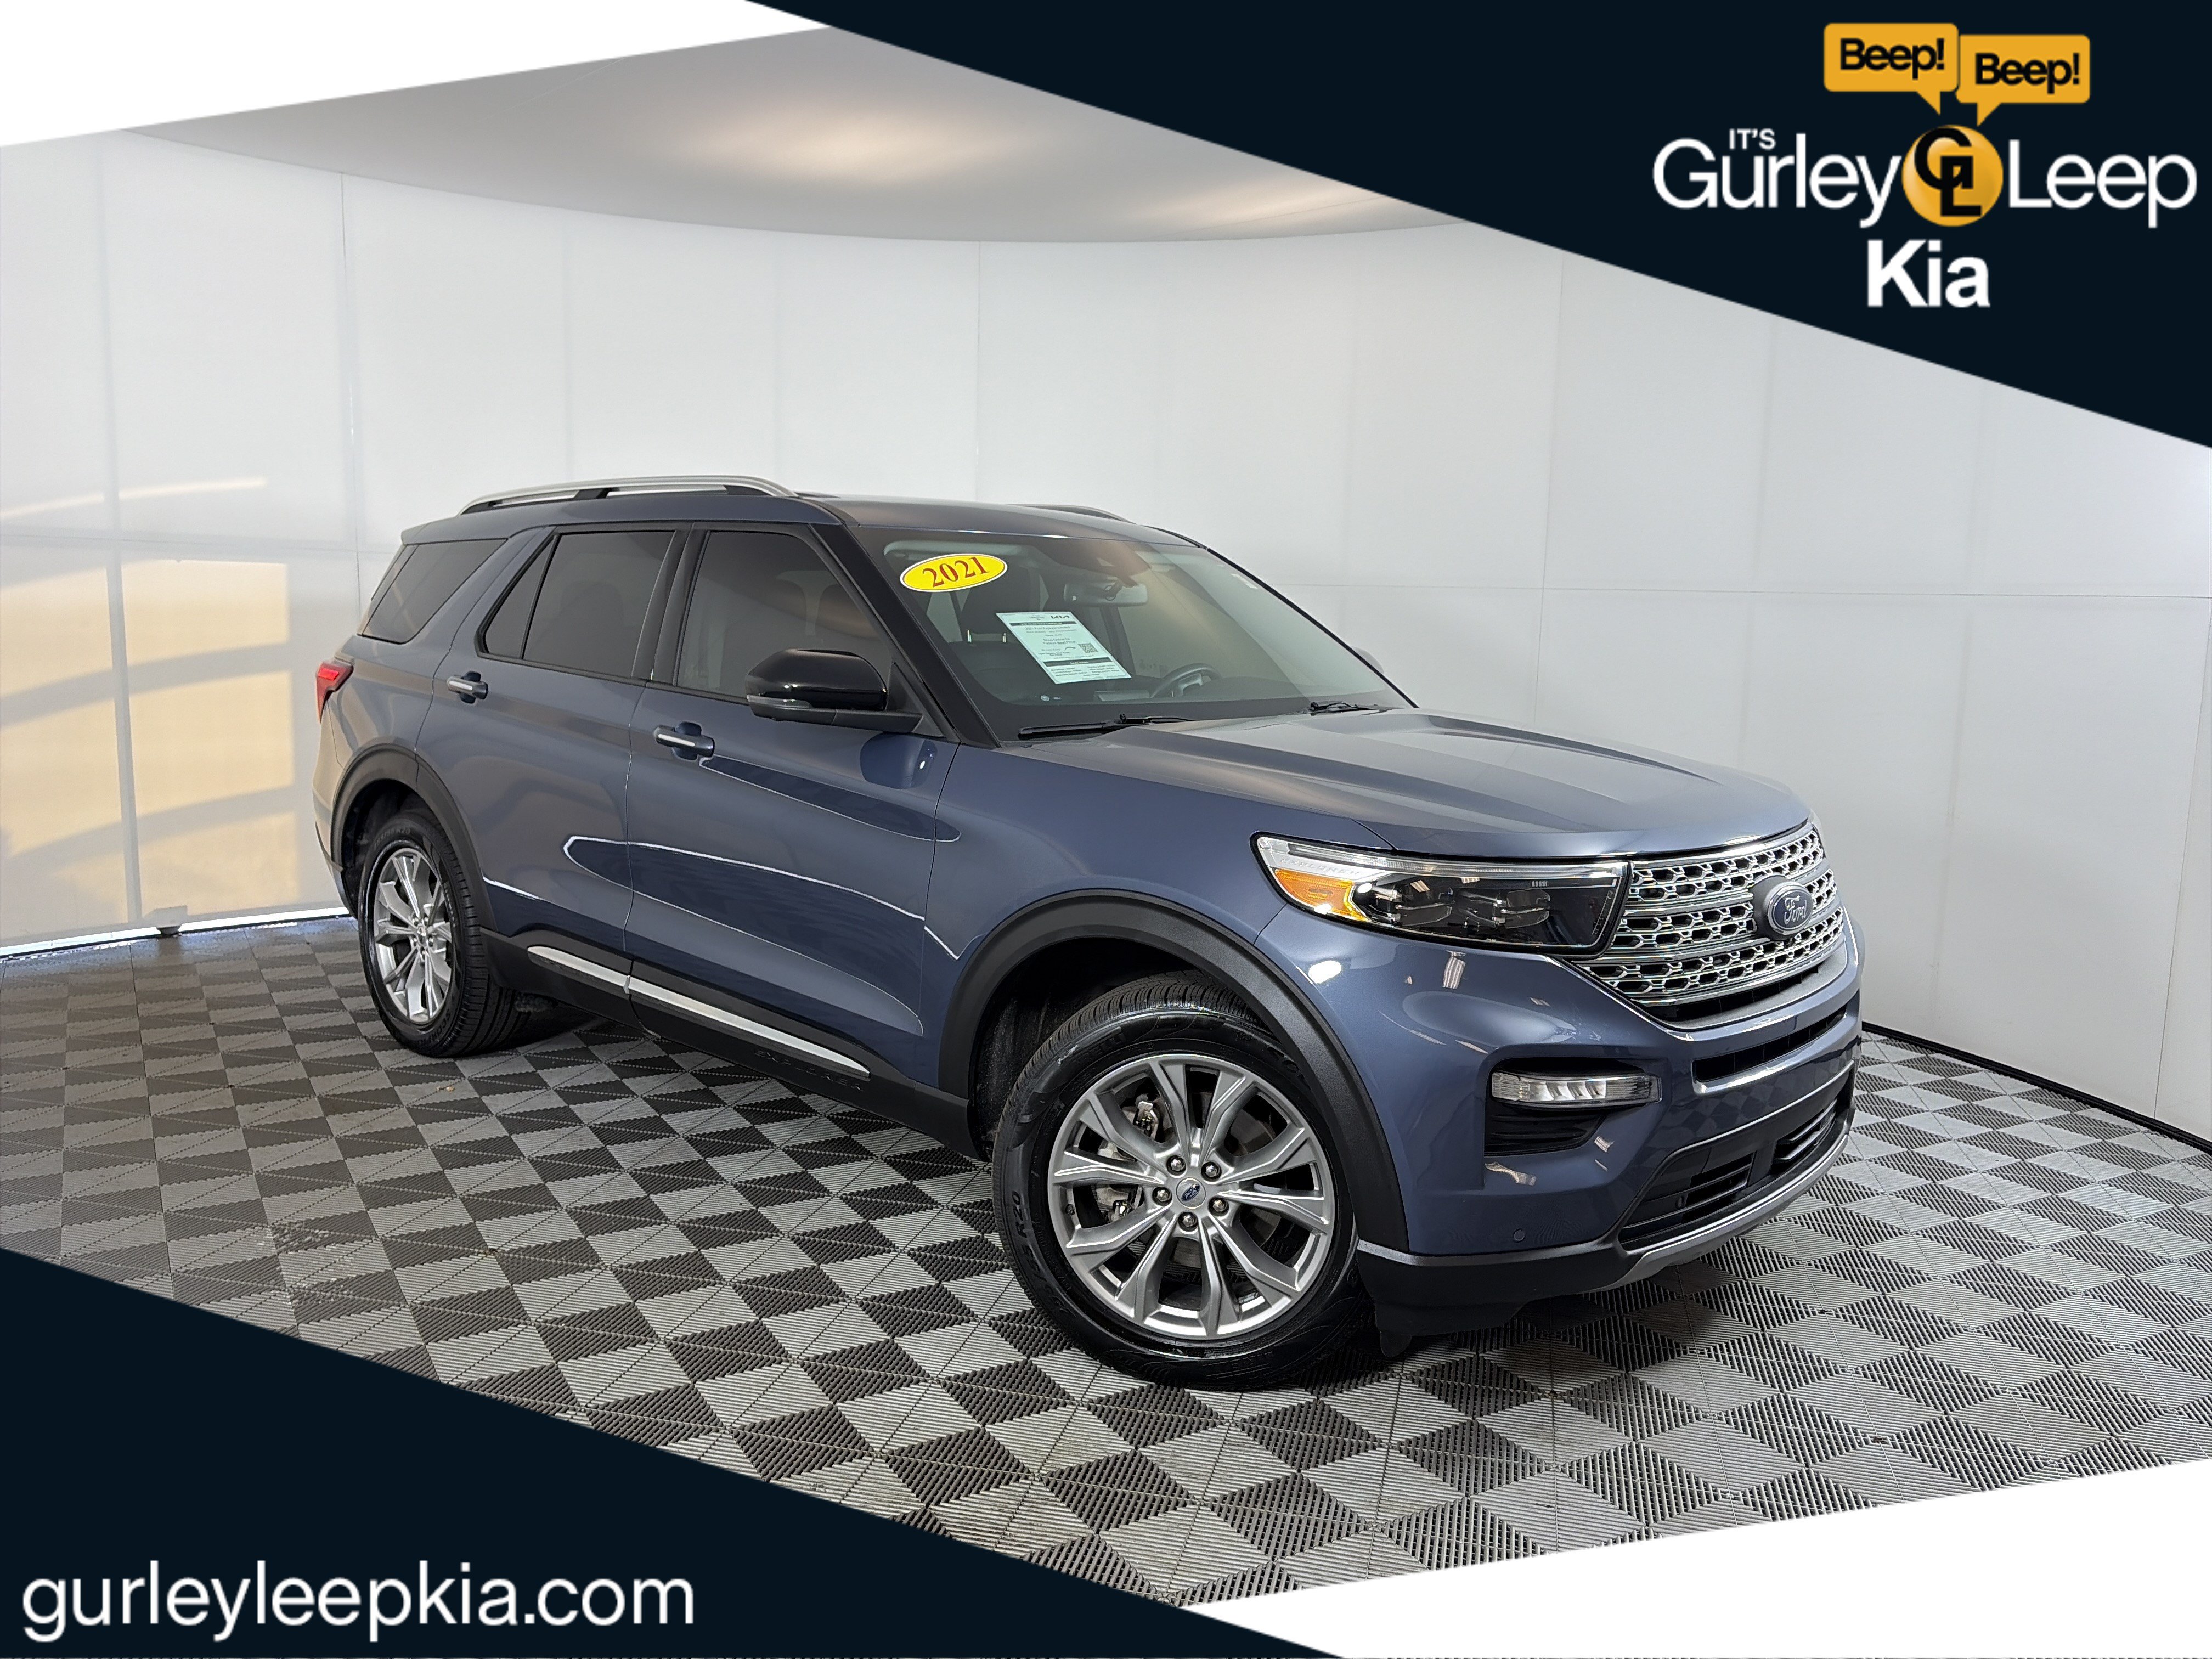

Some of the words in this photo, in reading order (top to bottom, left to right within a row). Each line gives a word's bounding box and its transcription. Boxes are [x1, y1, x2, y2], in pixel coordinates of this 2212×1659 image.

[922, 556, 990, 588] 2021
[1784, 894, 1808, 925] Ford
[754, 1048, 864, 1092] EXPLORER
[1012, 1190, 1028, 1239] R20
